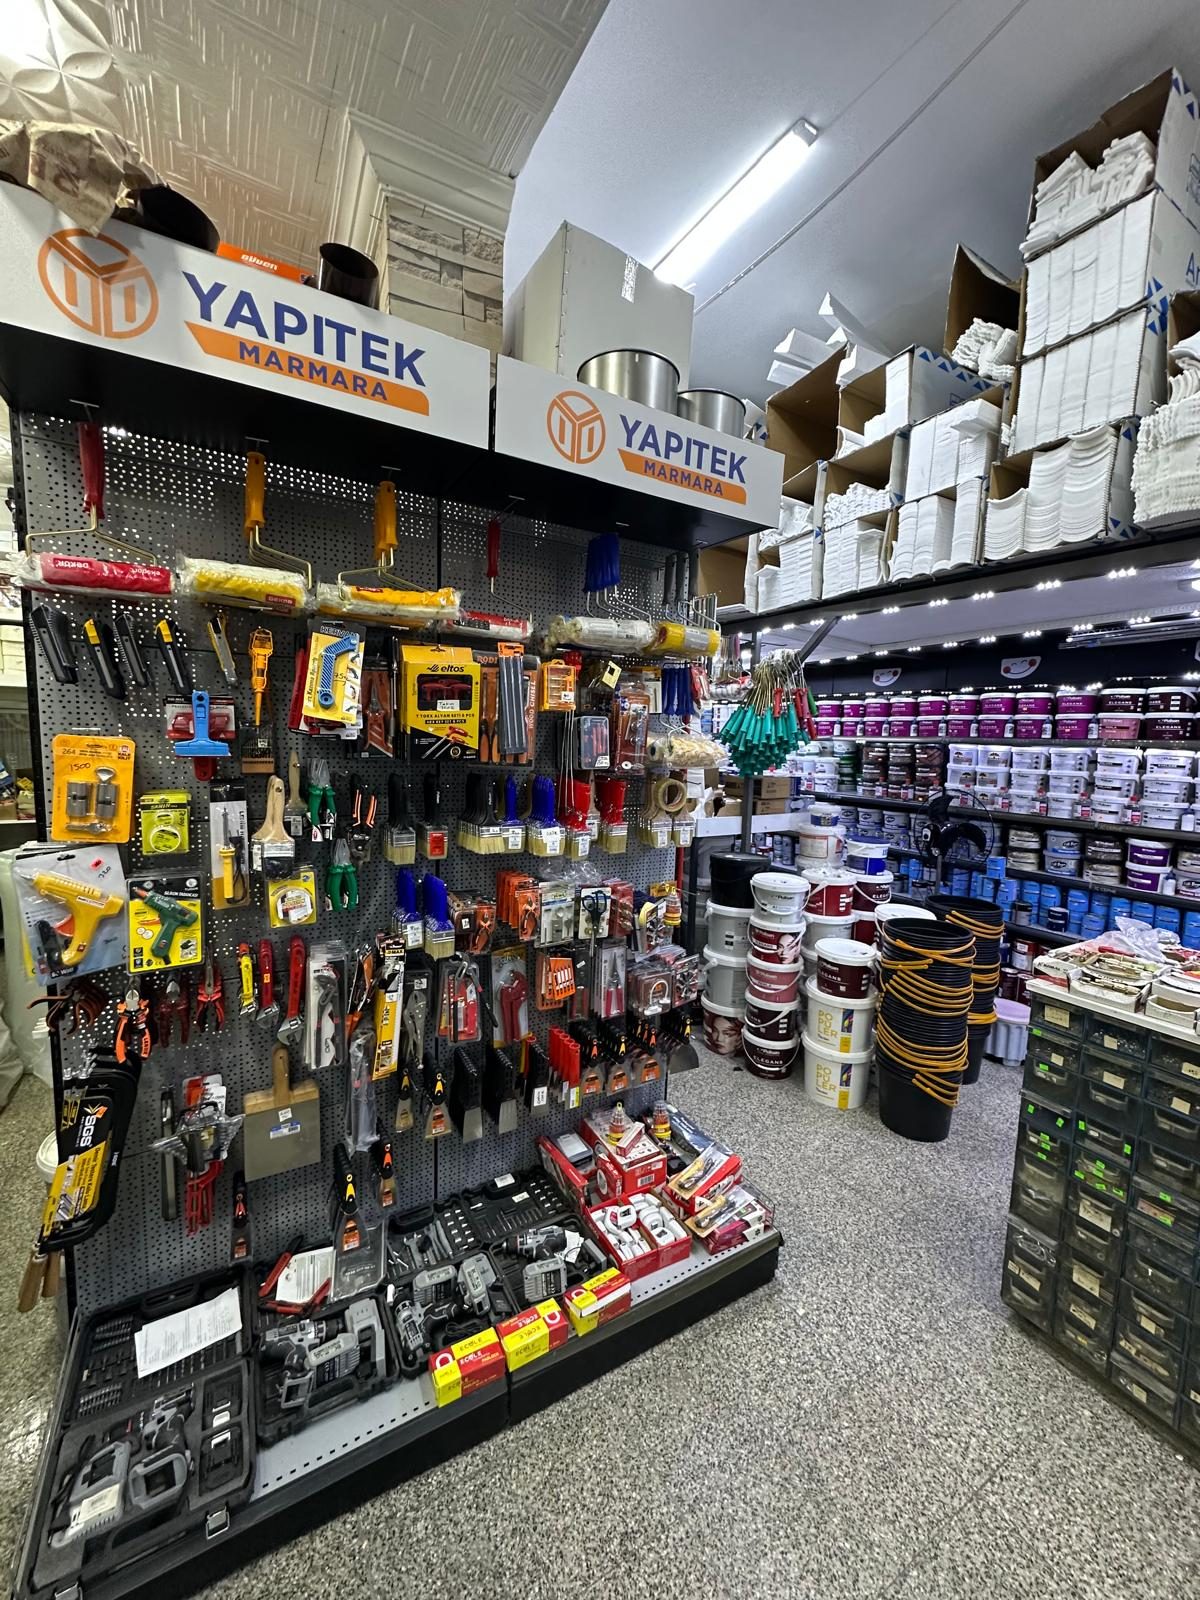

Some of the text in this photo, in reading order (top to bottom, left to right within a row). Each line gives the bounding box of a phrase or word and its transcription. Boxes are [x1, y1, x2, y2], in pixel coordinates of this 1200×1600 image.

[182, 270, 427, 387] YAPITEK
[238, 340, 388, 401] MARMARA
[619, 414, 748, 484] YAPITEK
[643, 460, 724, 497] MARMARA
[441, 664, 465, 673] eltos
[527, 680, 537, 729] WOOD CHISEL
[70, 762, 91, 772] 1500
[817, 1009, 833, 1021] PO
[817, 1024, 838, 1038] LER
[752, 1055, 783, 1065] ELEGANS
[816, 1063, 832, 1075] PO
[816, 1079, 837, 1092] LER
[80, 1115, 97, 1147] SGS
